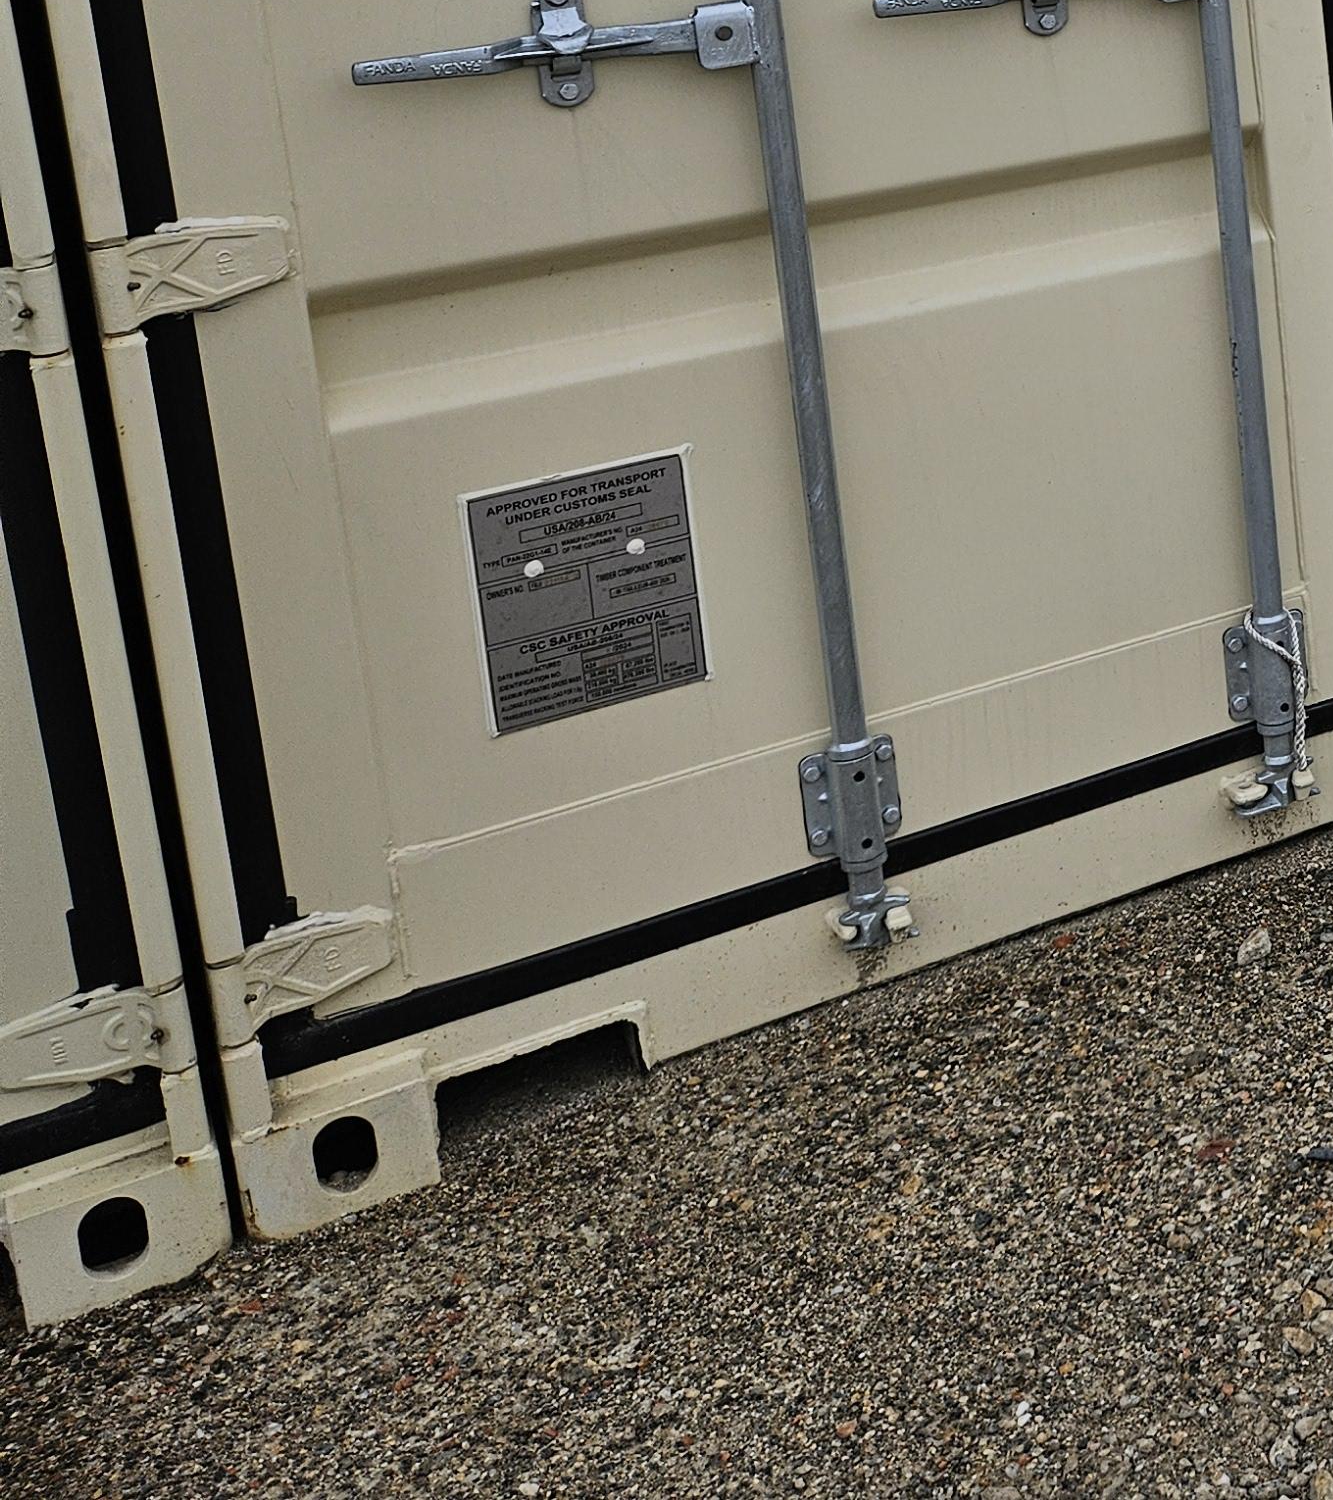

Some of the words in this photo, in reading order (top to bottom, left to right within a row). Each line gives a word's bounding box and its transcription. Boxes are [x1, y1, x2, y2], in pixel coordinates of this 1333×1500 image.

[486, 492, 557, 517] APPROVED
[561, 486, 588, 501] FOR
[591, 468, 666, 492] TRANSPORT
[505, 508, 550, 525] UNDER
[554, 492, 616, 513] CUSTOMS
[619, 485, 652, 499] SEAL
[520, 640, 546, 654] CSC
[549, 626, 598, 647] SAFETY
[602, 609, 670, 633] APPROVAL
